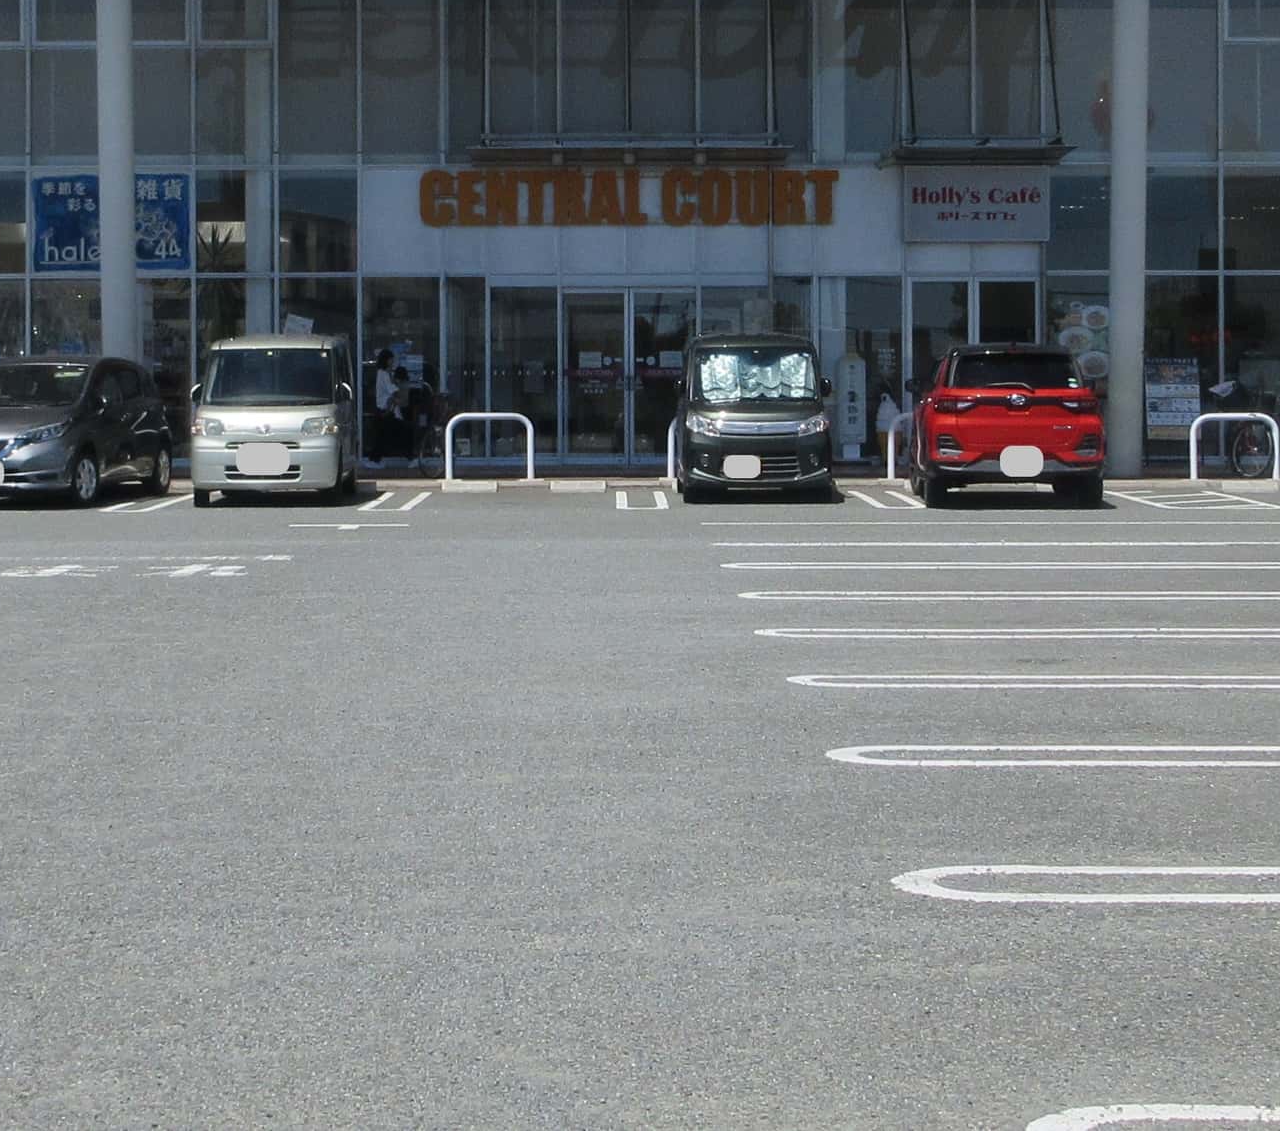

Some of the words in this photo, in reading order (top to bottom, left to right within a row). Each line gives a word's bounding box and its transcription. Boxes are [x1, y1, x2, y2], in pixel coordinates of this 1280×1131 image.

[41, 181, 86, 197] 季節を
[136, 179, 185, 201] 雑貨
[419, 168, 648, 227] CENTRAL
[661, 168, 839, 227] COURT
[911, 186, 981, 206] Holly's
[988, 186, 1041, 205] Café
[67, 198, 97, 212] 彩る
